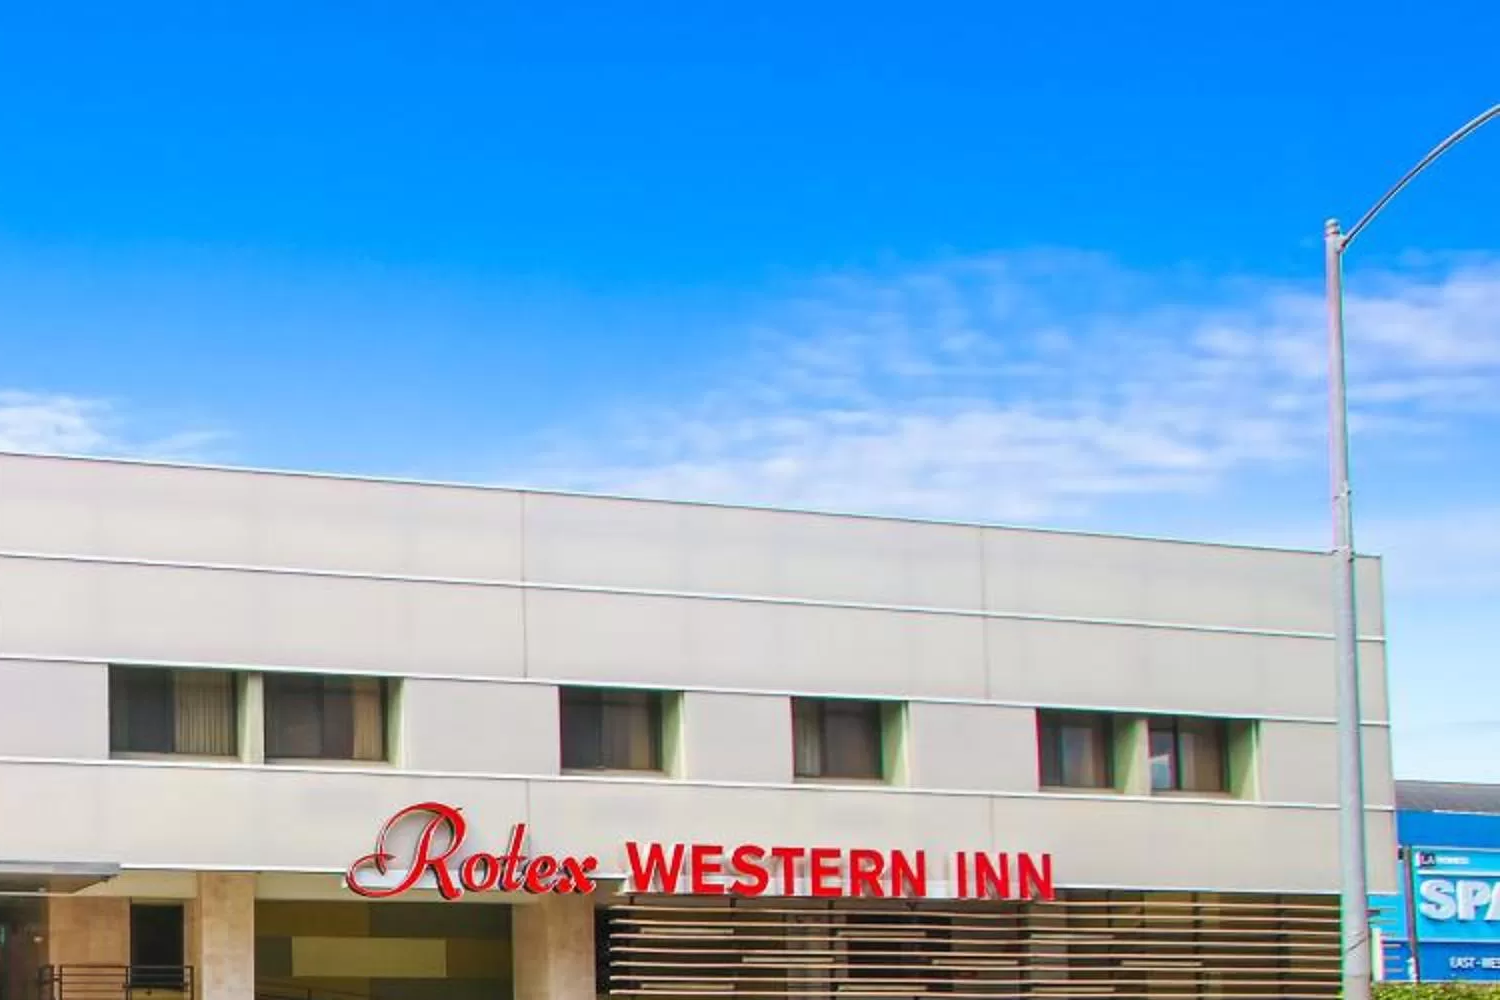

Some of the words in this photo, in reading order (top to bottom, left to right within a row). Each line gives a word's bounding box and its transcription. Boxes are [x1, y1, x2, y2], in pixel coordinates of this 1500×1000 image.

[345, 802, 599, 901] Rotex
[626, 841, 926, 899] WESTERN
[955, 852, 1055, 902] INN
